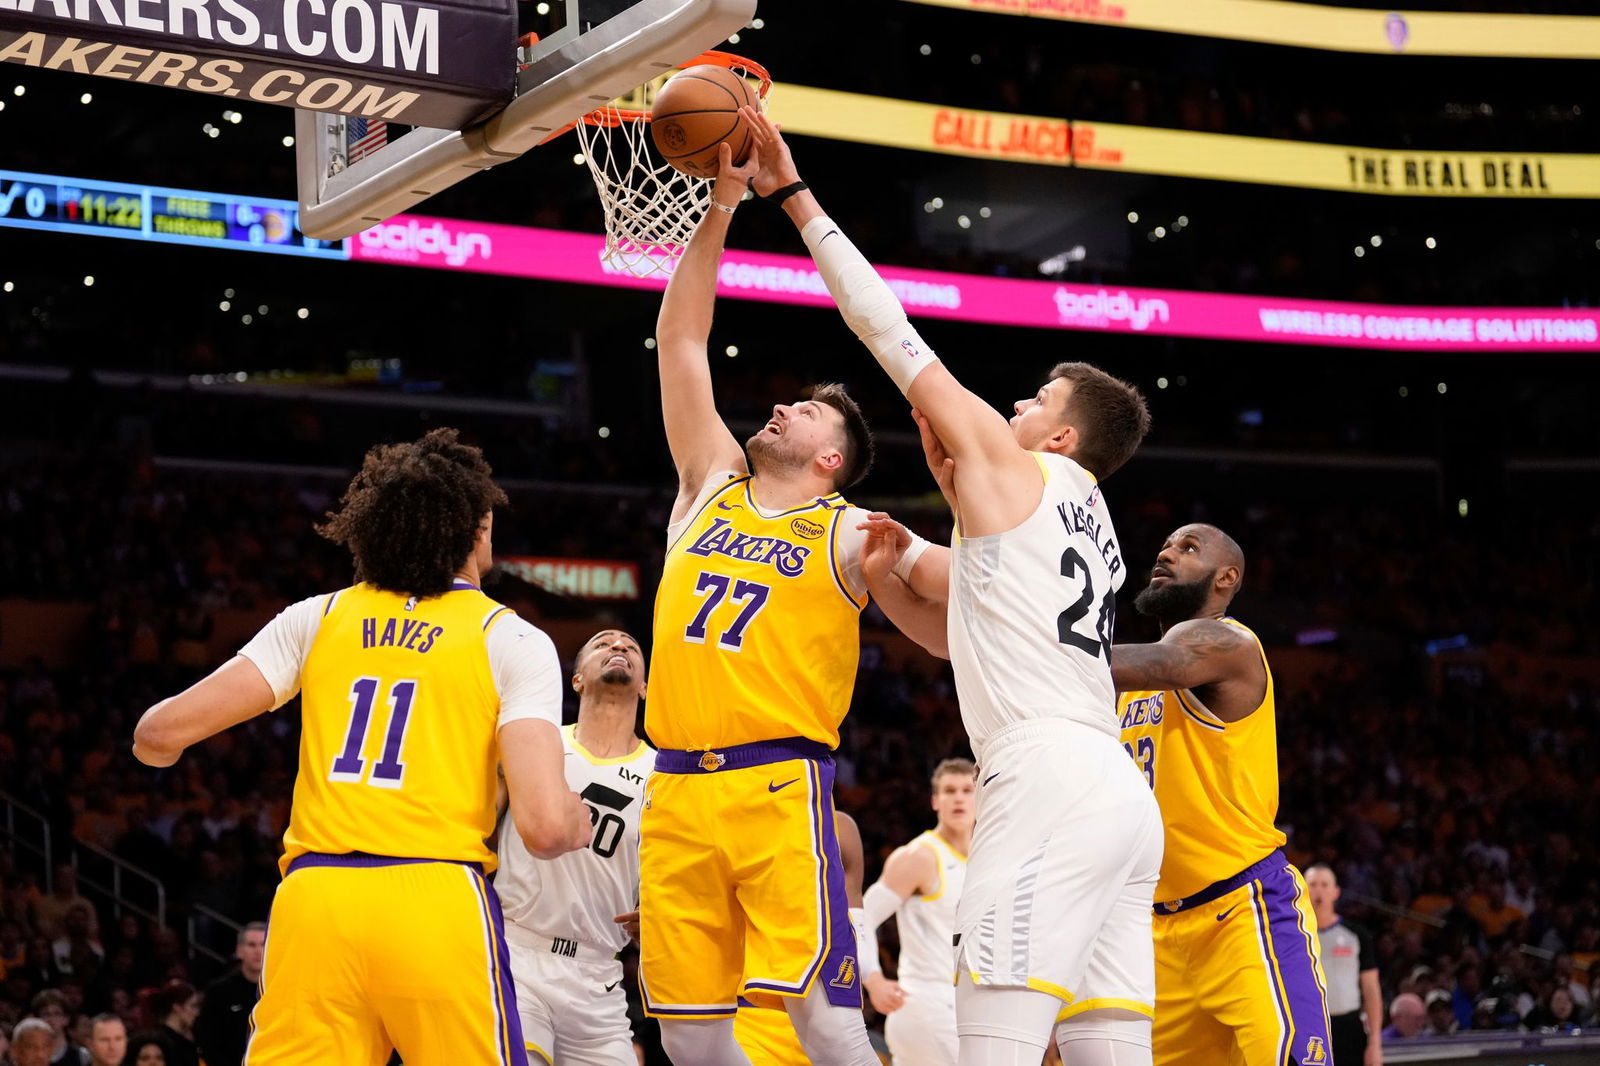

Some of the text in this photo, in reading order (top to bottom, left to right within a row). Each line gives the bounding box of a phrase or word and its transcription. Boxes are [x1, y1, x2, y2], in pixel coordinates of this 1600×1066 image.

[932, 108, 991, 151] CALL
[1347, 155, 1549, 190] THE REAL DEAL
[81, 193, 141, 229] 11:22
[1259, 308, 1598, 341] WIRELESS COVERAGE SOLUTIONS
[794, 520, 823, 536] bibigo
[1057, 501, 1121, 580] KESSLER
[684, 516, 812, 578] LAKERS
[684, 570, 771, 653] 77
[362, 617, 444, 654] HAYES
[1119, 691, 1164, 729] KERS
[328, 675, 418, 790] 11
[618, 766, 644, 785] LVT
[551, 937, 578, 958] UTAH
